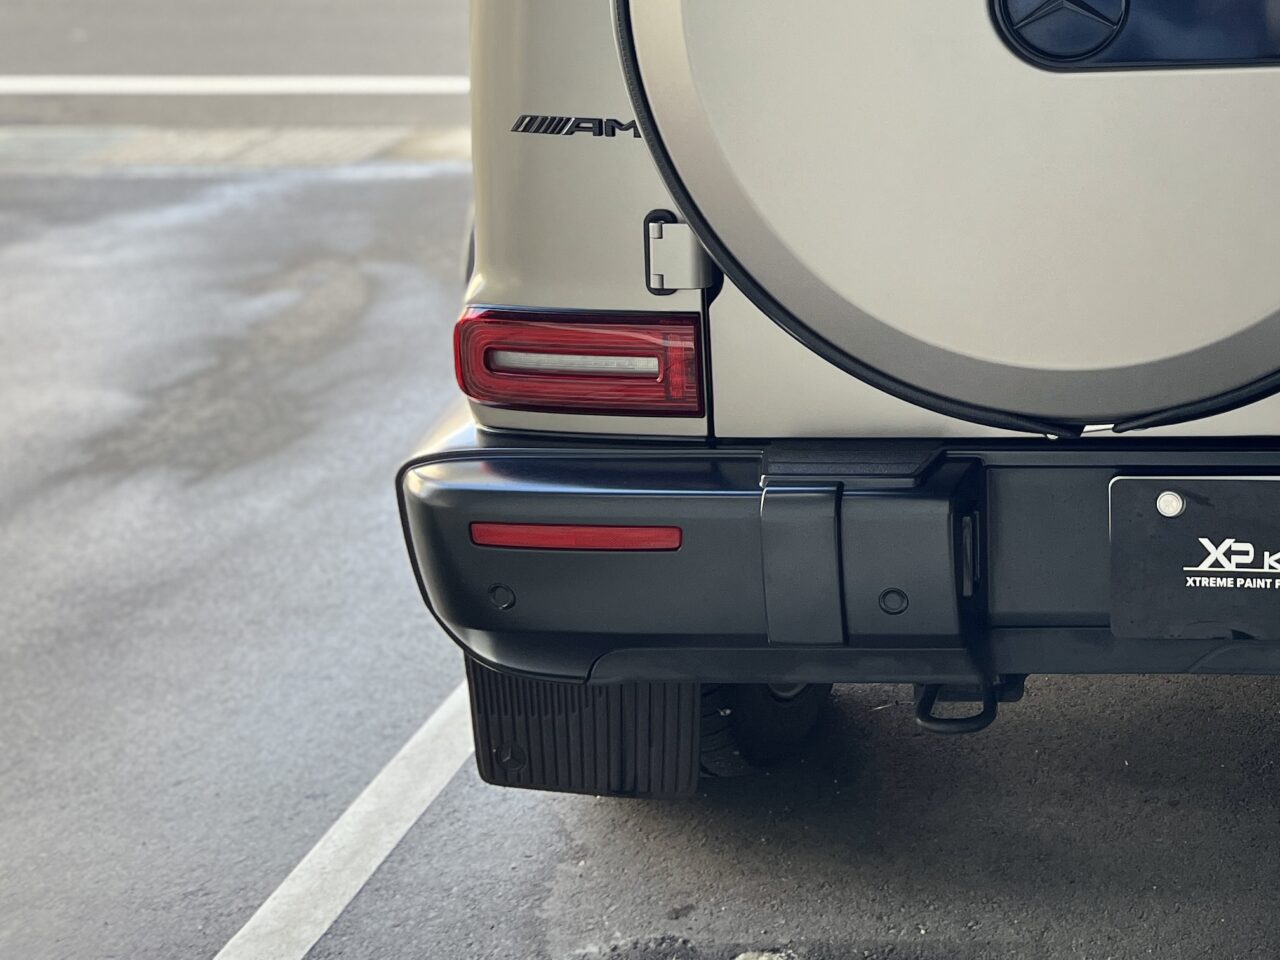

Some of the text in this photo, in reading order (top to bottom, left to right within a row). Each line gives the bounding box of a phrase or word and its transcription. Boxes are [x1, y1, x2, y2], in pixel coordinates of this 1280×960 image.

[562, 117, 643, 139] AM
[1198, 537, 1255, 571] XP
[1185, 576, 1234, 588] XTREME
[1236, 578, 1272, 589] PAINT
